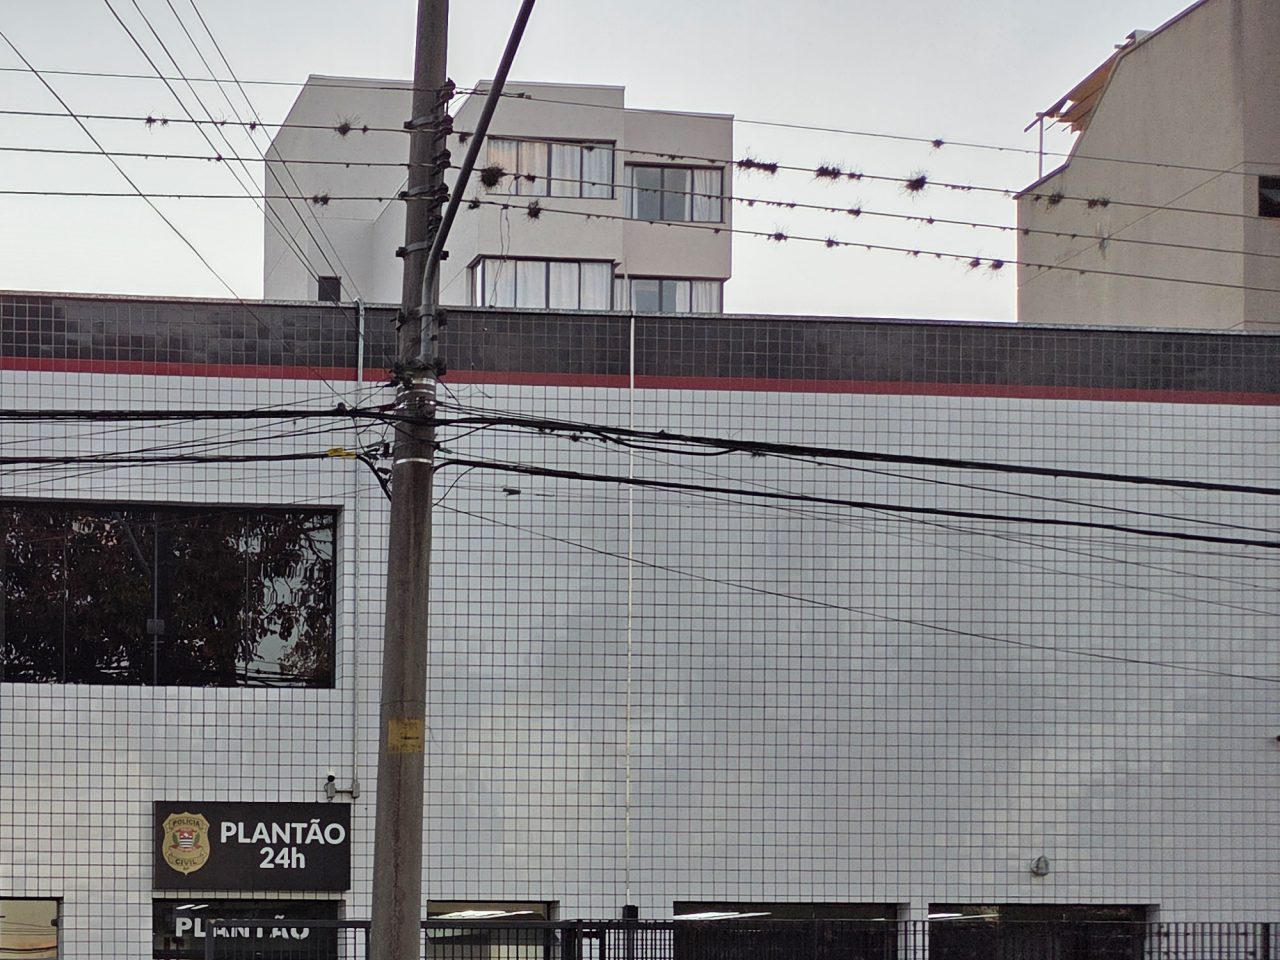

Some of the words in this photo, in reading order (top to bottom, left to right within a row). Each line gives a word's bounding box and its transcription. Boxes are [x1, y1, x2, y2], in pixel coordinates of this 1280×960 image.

[220, 818, 346, 845] PLANTÃO
[175, 858, 198, 867] CIVIL
[259, 847, 306, 869] 24h
